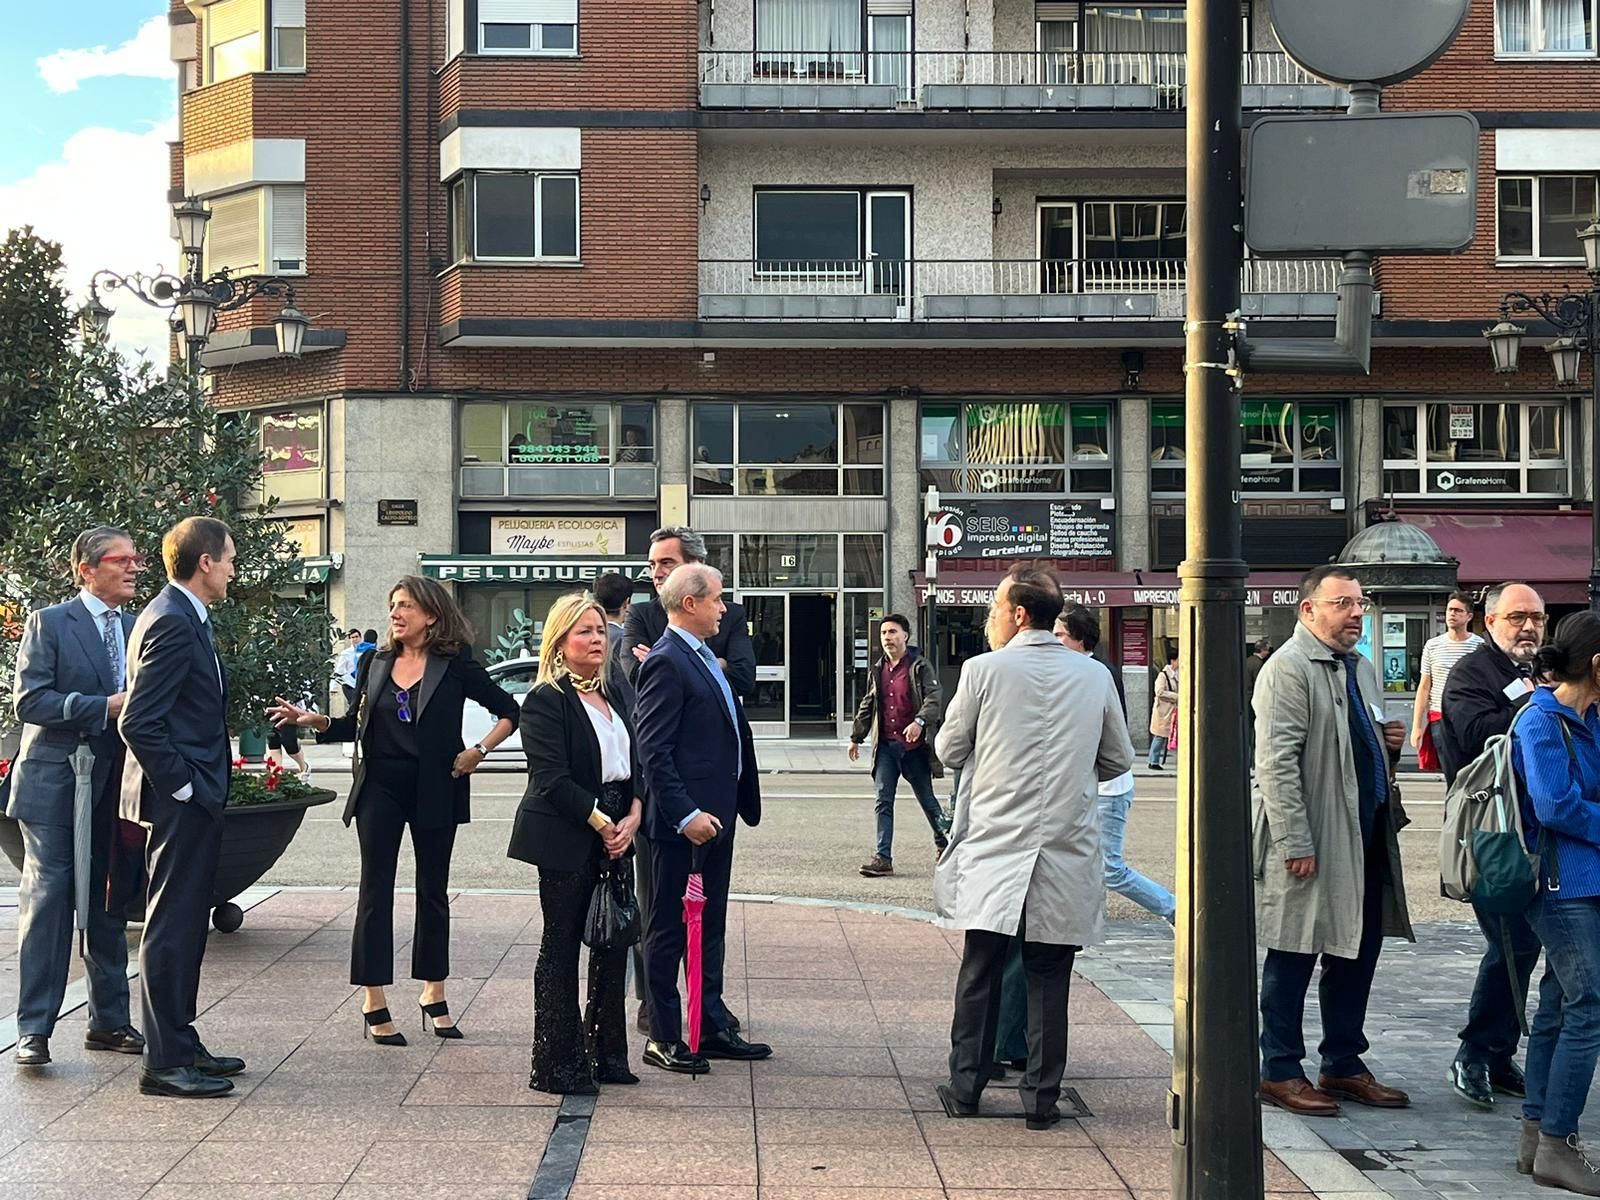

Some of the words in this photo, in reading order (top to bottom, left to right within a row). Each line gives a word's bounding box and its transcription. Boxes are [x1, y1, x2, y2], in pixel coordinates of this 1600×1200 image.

[999, 476, 1052, 485] GrafenoHome
[1241, 475, 1280, 484] fenoHome
[498, 520, 556, 530] PELUQUERIA
[558, 520, 619, 530] ECOLOGICA
[966, 516, 1010, 533] SEIS
[967, 532, 1015, 544] impresión
[1017, 532, 1048, 544] digital
[506, 535, 555, 554] Maybe
[783, 556, 795, 566] 16
[921, 590, 955, 604] PANOS
[961, 590, 994, 604] SCANEA
[1272, 591, 1299, 605] ENCUA
